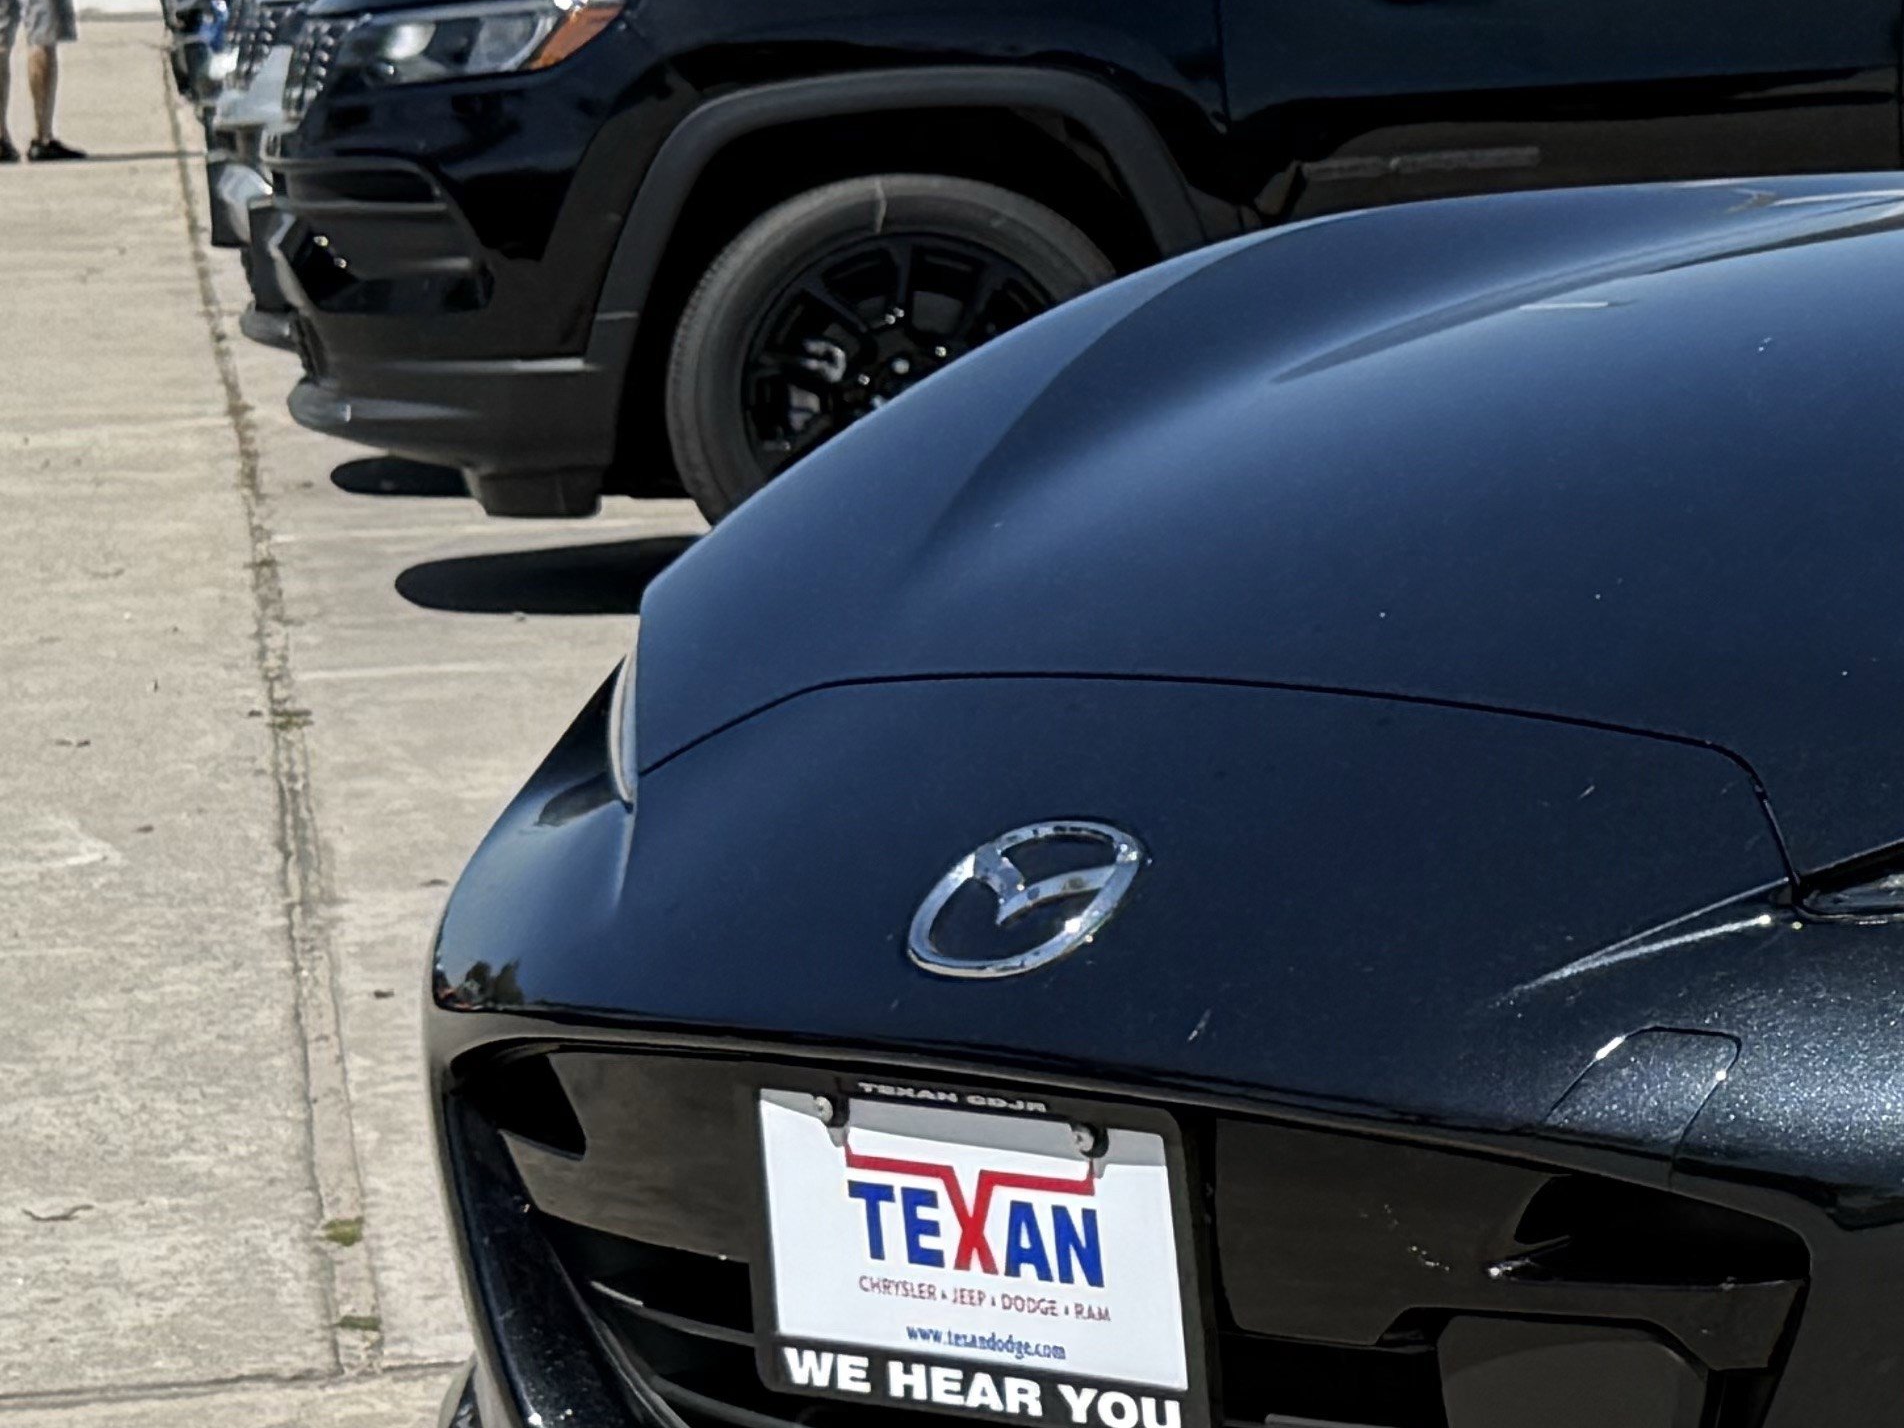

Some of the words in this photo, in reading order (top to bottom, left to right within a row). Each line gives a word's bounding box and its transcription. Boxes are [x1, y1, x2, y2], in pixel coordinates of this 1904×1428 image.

[857, 1081, 958, 1104] TEXAN
[846, 1156, 1105, 1288] TEXAN
[858, 1274, 937, 1301] CHRYSLER
[951, 1286, 987, 1308] JEEP
[1001, 1293, 1059, 1318] DODGE
[1073, 1302, 1112, 1323] RAM
[782, 1346, 872, 1394] WE
[887, 1359, 1044, 1418] HEAR
